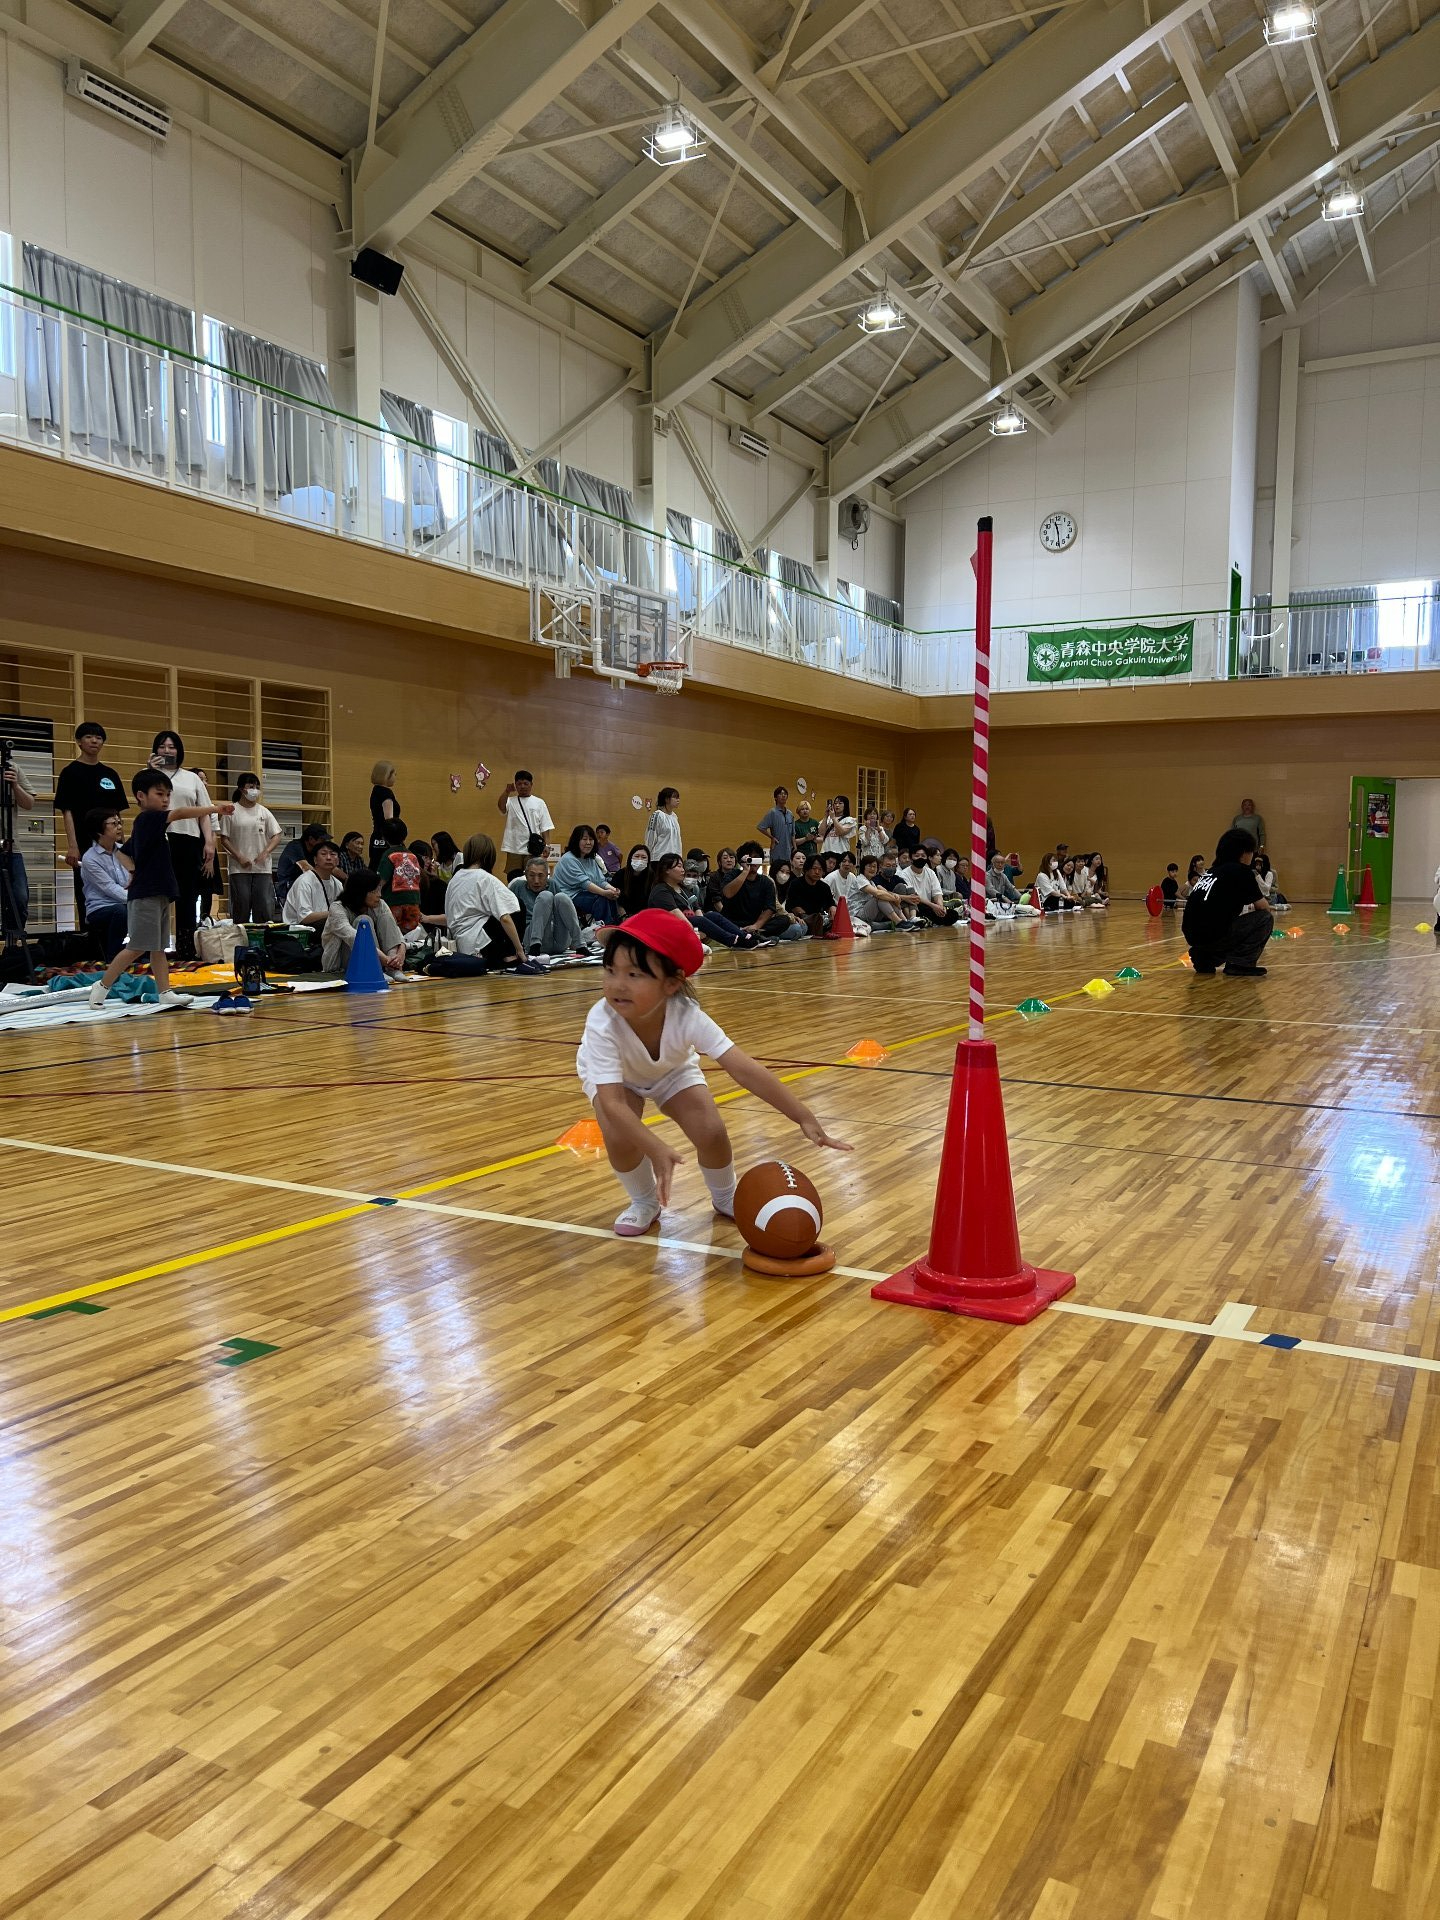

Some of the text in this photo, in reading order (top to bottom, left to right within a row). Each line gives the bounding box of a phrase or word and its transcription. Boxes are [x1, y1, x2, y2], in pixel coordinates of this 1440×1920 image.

[1060, 633, 1189, 659] 青森中央学院大学
[1059, 652, 1188, 669] Aomori Chuo Gakuin University
